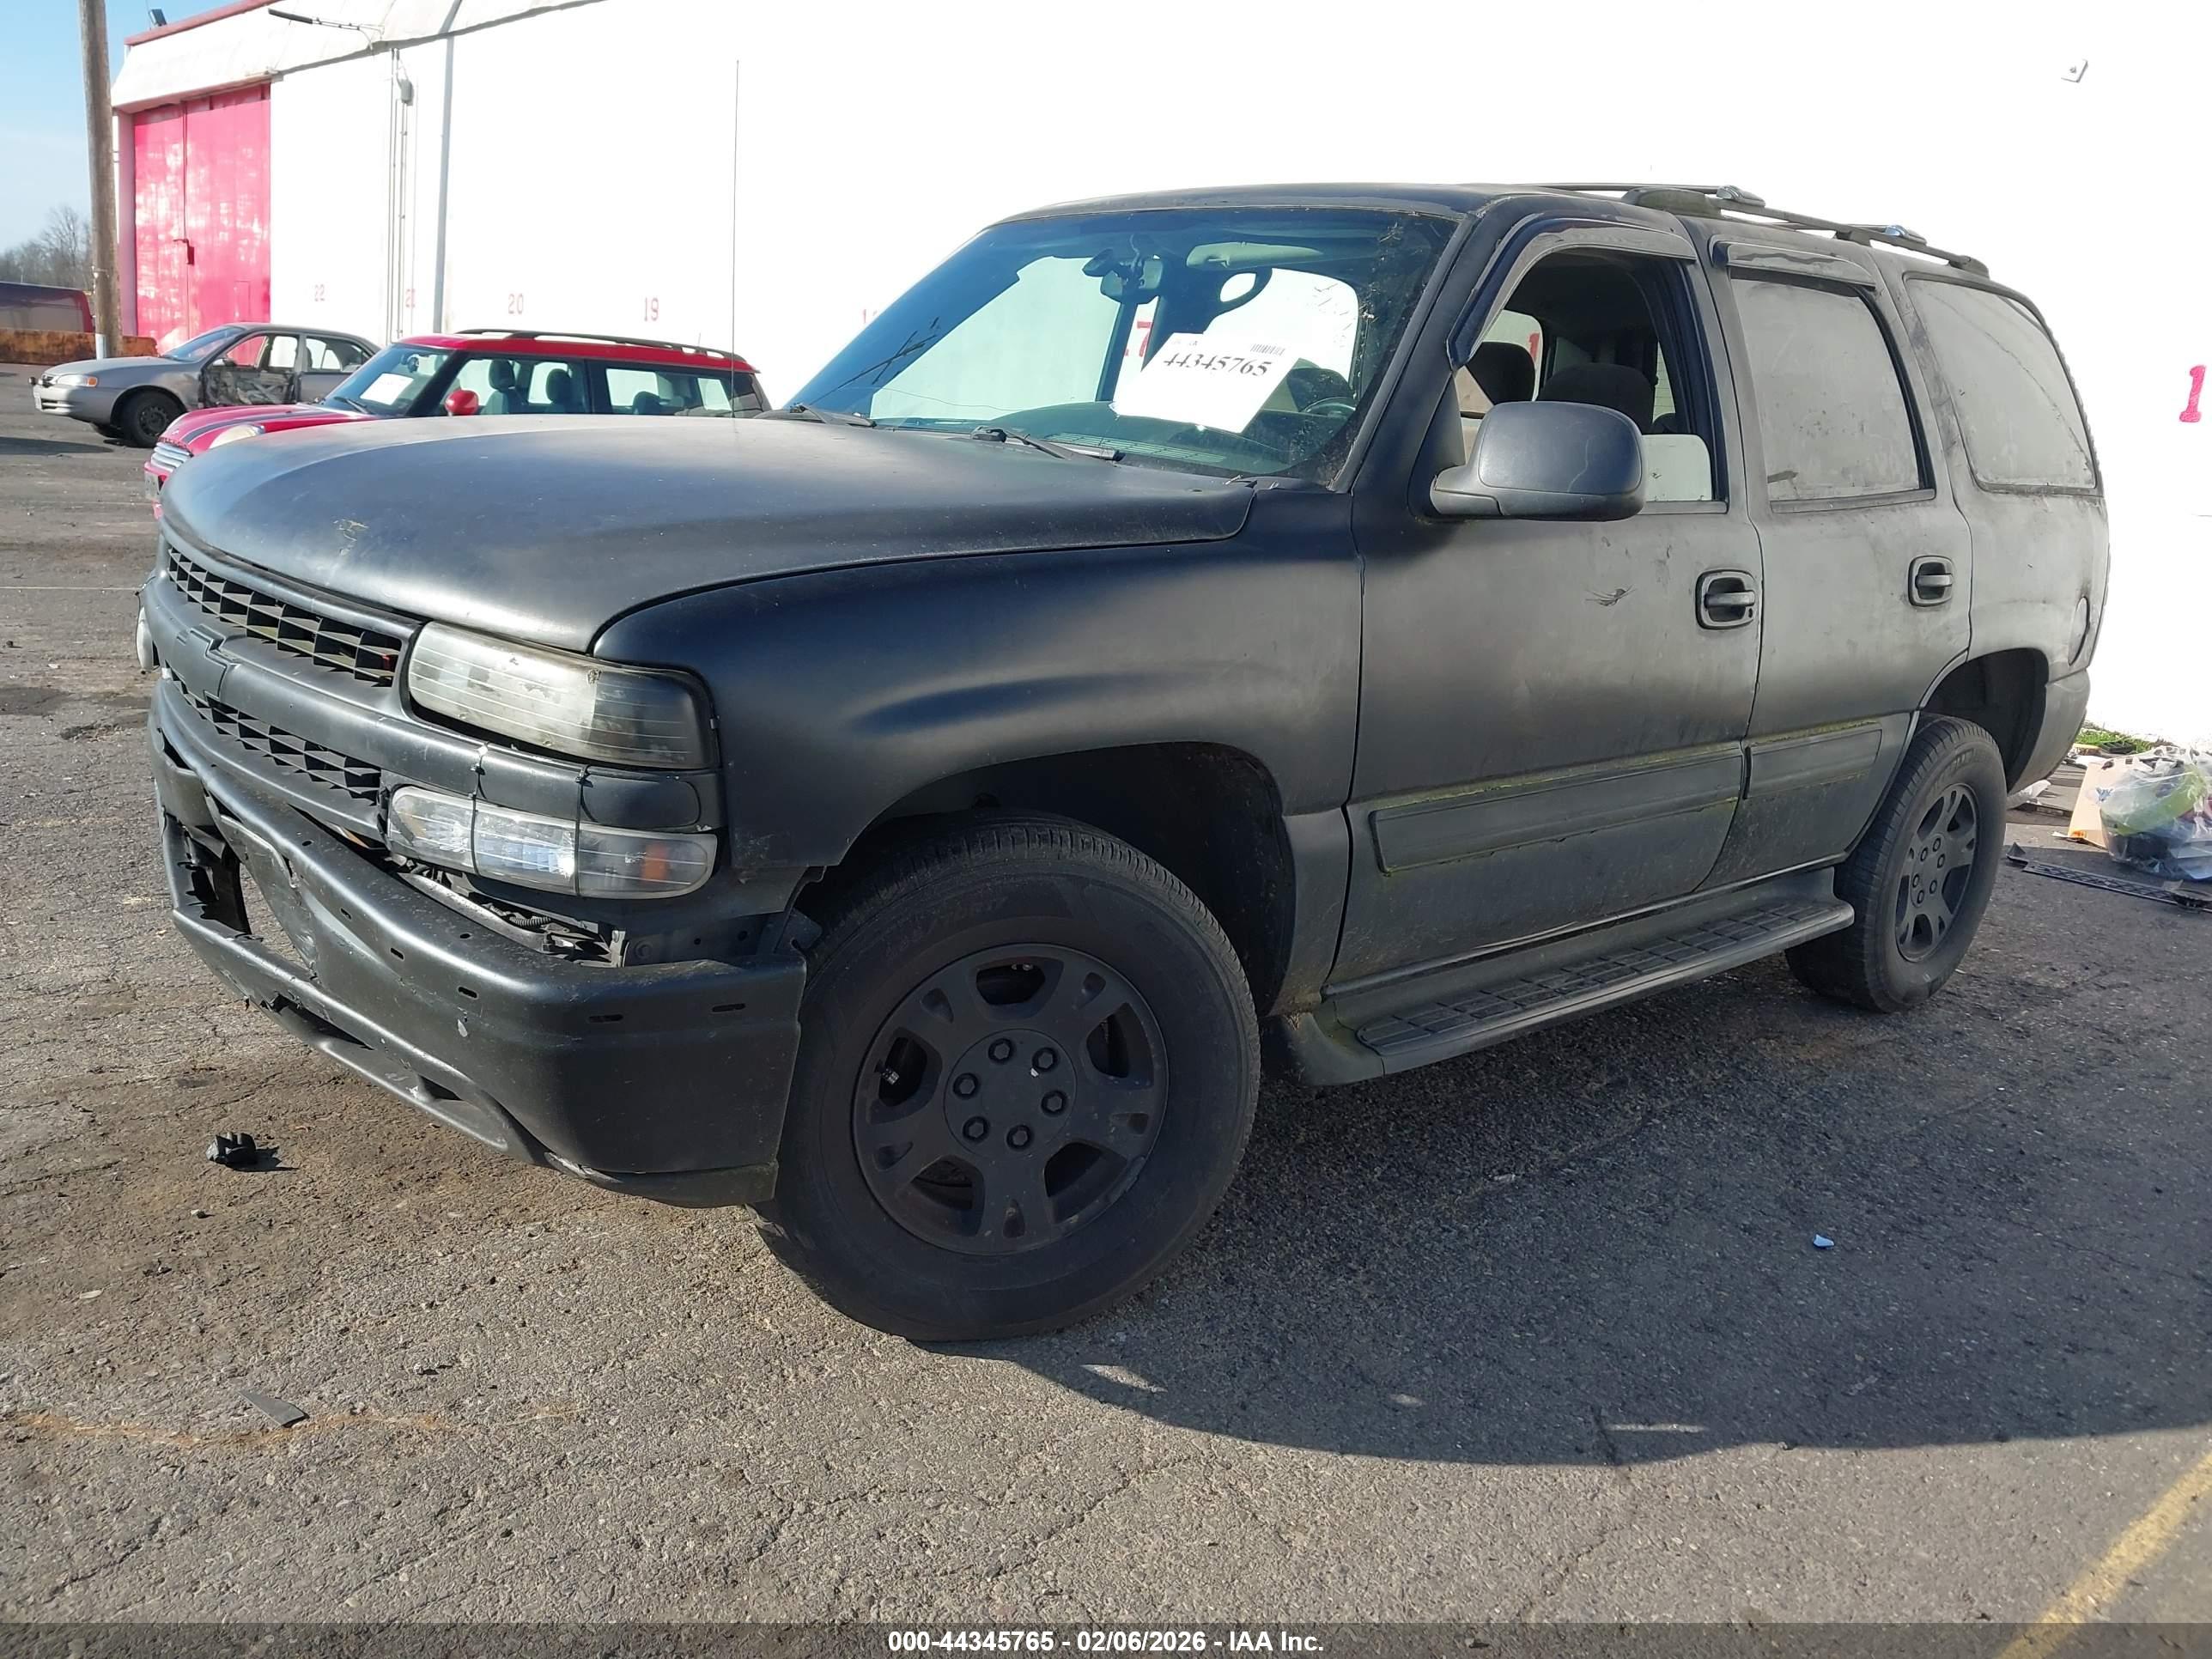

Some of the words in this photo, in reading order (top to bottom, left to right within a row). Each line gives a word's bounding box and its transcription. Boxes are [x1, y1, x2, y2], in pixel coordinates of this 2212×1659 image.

[507, 293, 524, 314] 20
[643, 296, 659, 321] 19
[1163, 352, 1273, 376] 44345765
